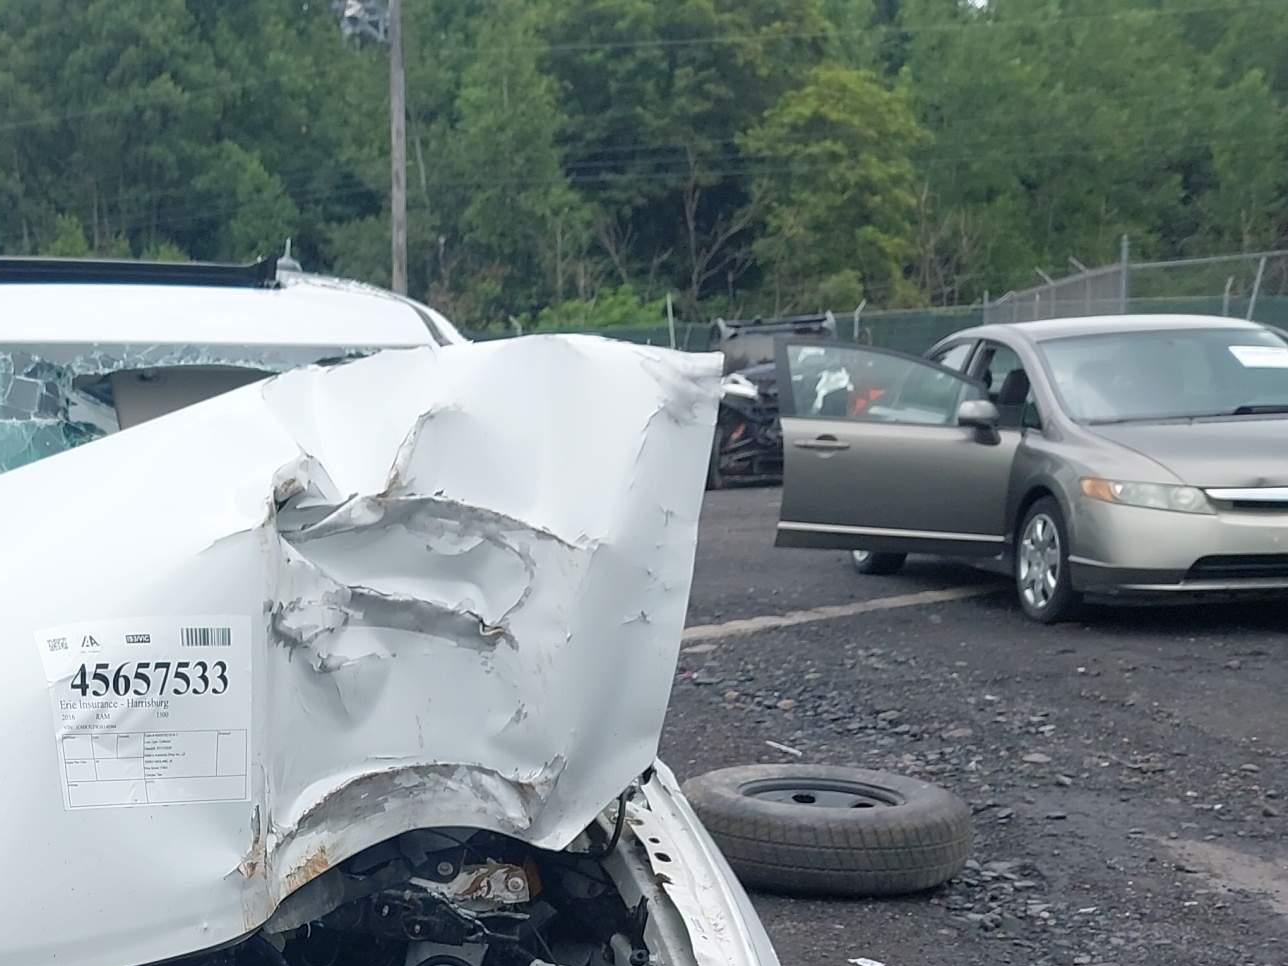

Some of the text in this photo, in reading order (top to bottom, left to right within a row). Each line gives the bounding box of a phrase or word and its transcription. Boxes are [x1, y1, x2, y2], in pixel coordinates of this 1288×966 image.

[70, 660, 229, 697] 45657533
[60, 699, 77, 710] Erie
[79, 699, 118, 709] Insurance
[127, 698, 169, 709] Harrisburg
